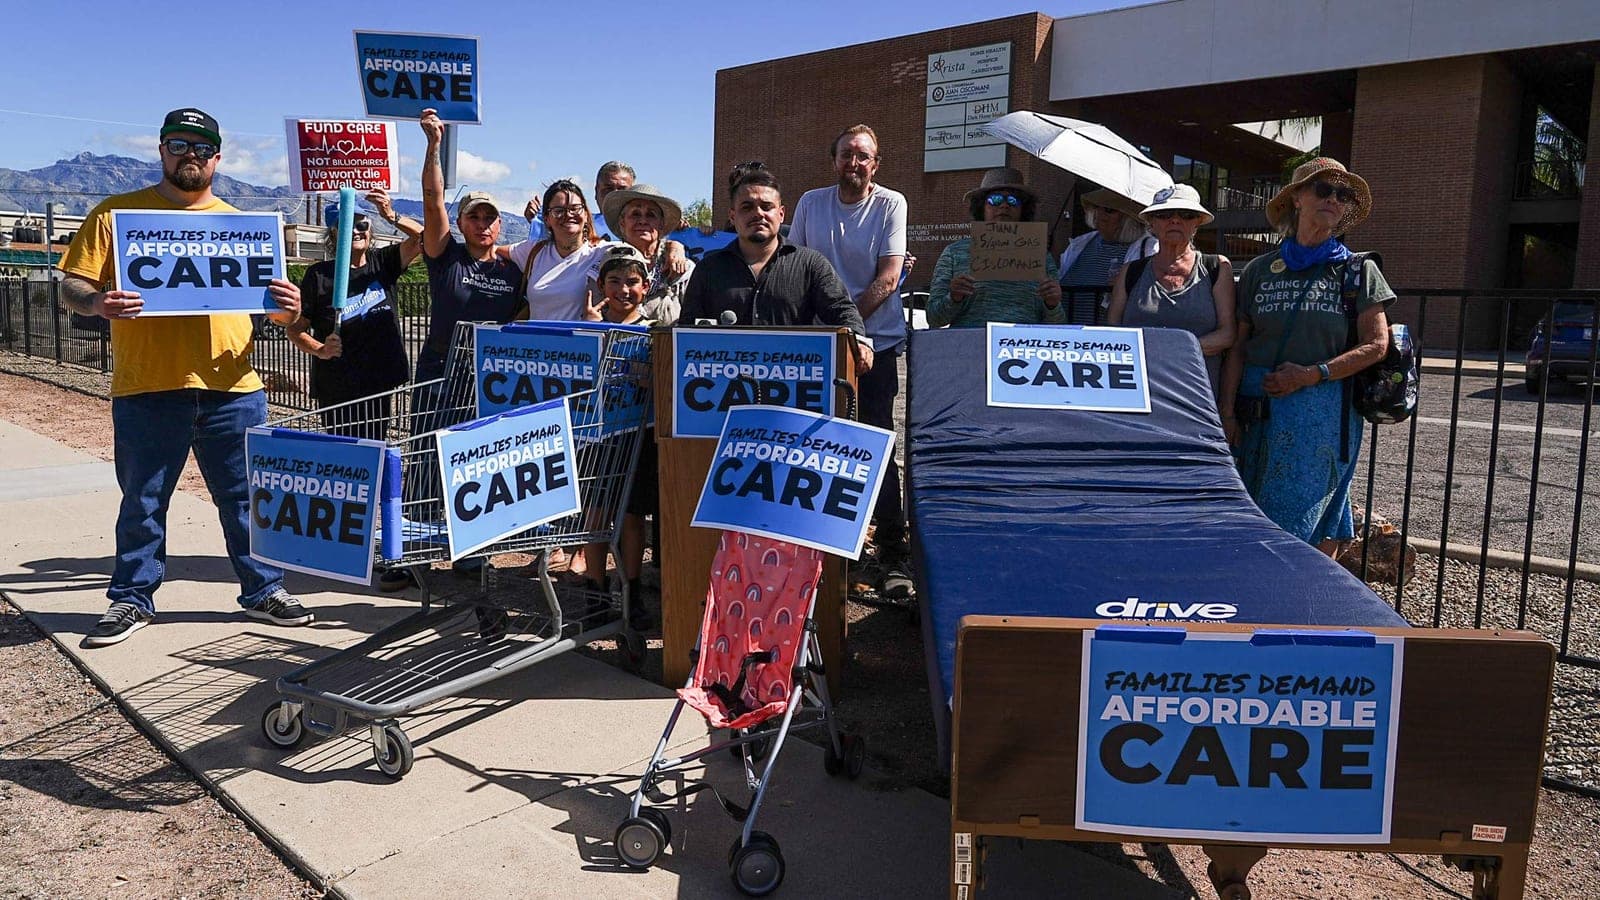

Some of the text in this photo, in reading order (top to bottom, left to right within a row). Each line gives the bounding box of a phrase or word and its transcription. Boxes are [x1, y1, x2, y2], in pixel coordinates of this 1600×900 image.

[363, 47, 470, 61] FAMILIES DEMAND
[364, 58, 472, 75] AFFORDABLE
[366, 70, 473, 102] CARE
[304, 122, 382, 134] FUND CARE
[307, 158, 330, 166] NOT
[307, 168, 380, 179] We won't die
[308, 180, 325, 190] for
[326, 180, 352, 189] Wall
[126, 230, 272, 241] FAMILIES DEMAND
[126, 242, 274, 256] AFFORDABLE
[127, 256, 274, 288] CARE
[1260, 280, 1300, 290] CARING
[1255, 291, 1288, 303] OTHER
[1292, 290, 1336, 301] POPLE
[1258, 302, 1280, 314] NOT
[482, 345, 592, 363] FAMILIES DEMAND
[998, 338, 1131, 352] FAMILIES DEMAND
[998, 348, 1134, 364] AFFORDABLE
[684, 350, 823, 364] FAMILIES DEMAND
[482, 358, 593, 380] AFFORDABLE
[683, 362, 824, 381] AFFORDABLE
[998, 358, 1138, 390] CARE
[683, 378, 824, 414] CARE
[450, 424, 561, 467] FAMILIES DEMAND
[728, 427, 873, 462] FAMILIES DEMAND
[252, 454, 369, 481] FAMILIES DEMAND
[452, 436, 564, 486] AFFORDABLE
[720, 442, 871, 483] AFFORDABLE
[251, 470, 369, 502] AFFORDABLE
[454, 452, 569, 522] CARE
[712, 458, 865, 522] CARE
[252, 488, 367, 546] CARE
[1095, 597, 1238, 619] drive
[1105, 670, 1375, 696] FAMILIES DEMAND
[1100, 695, 1377, 727] AFFORDABLE
[1099, 722, 1375, 790] CARE
